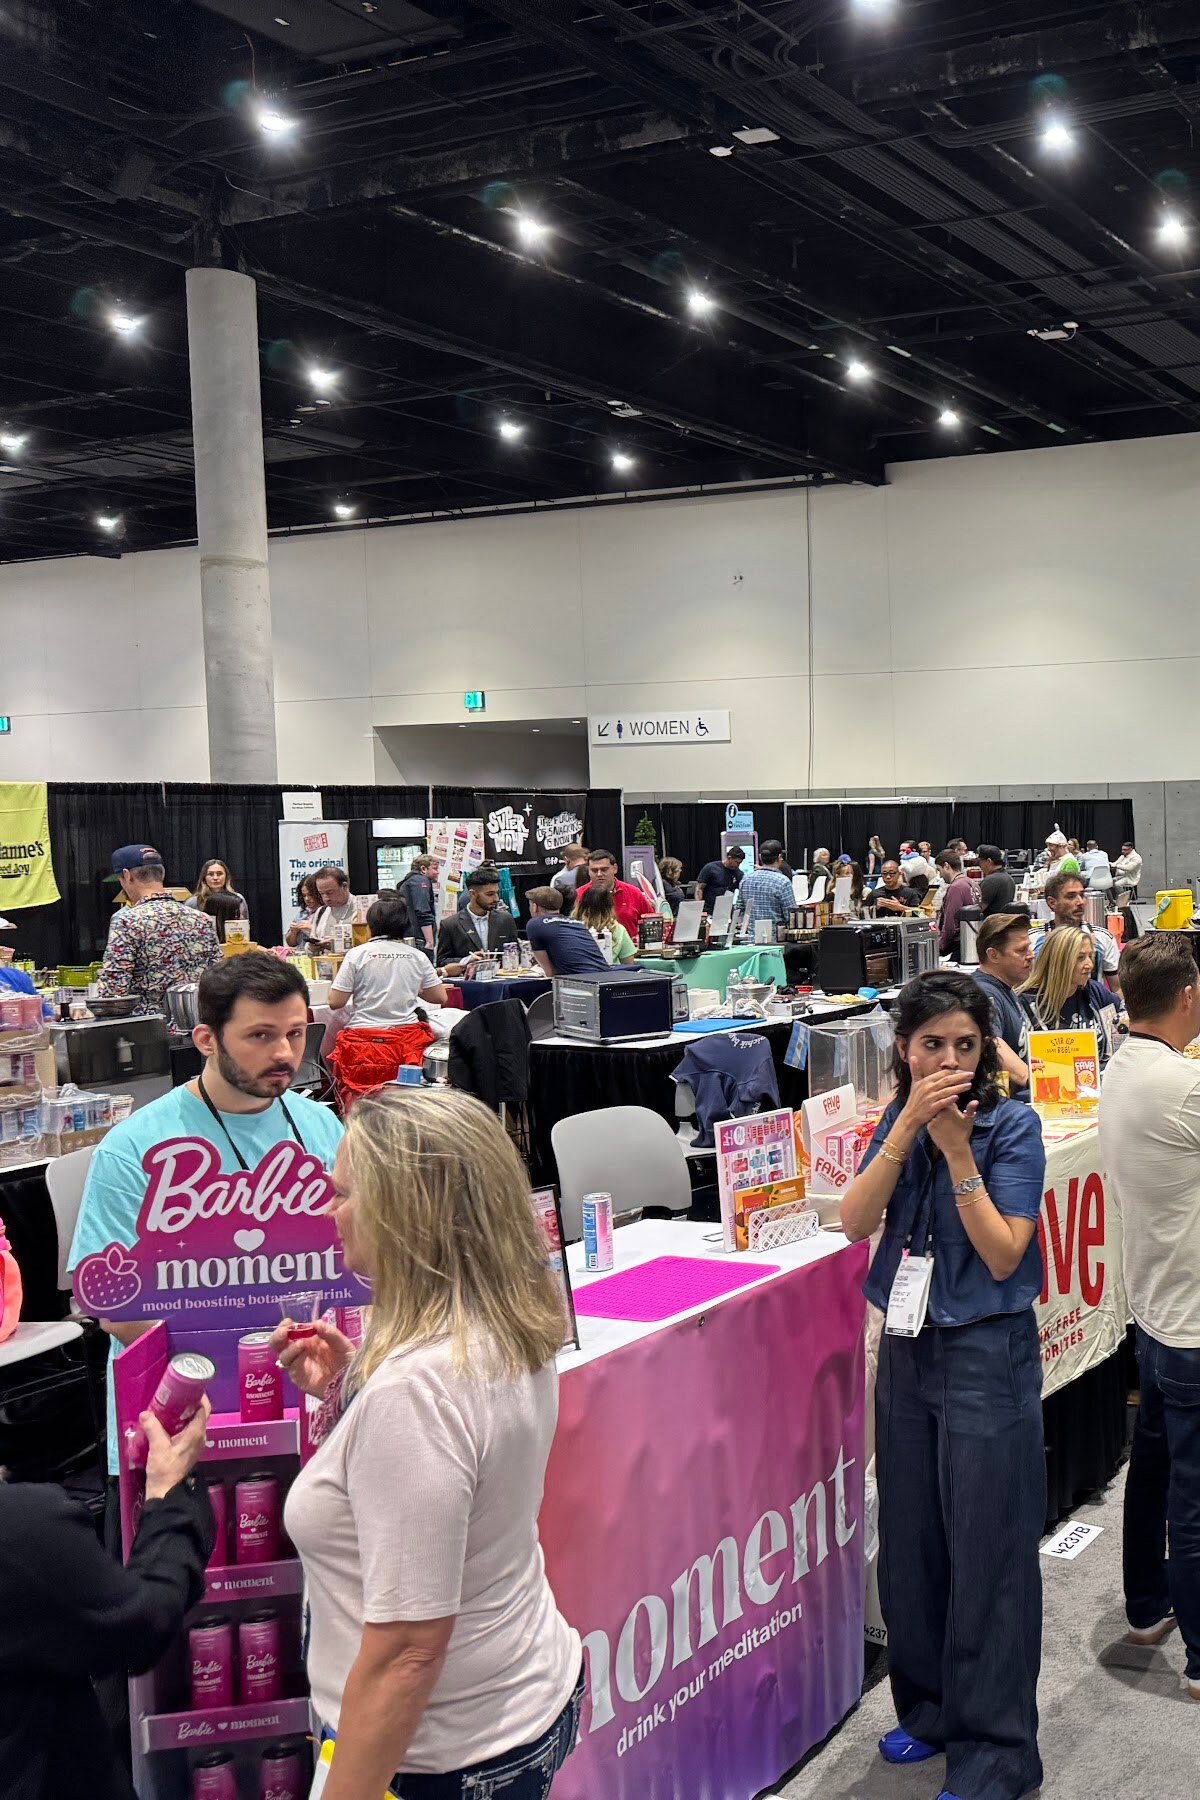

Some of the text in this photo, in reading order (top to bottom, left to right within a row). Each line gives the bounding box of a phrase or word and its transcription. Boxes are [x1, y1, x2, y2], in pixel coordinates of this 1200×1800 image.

[629, 720, 690, 736] WOMEN
[486, 806, 530, 833] SUPER
[289, 858, 344, 869] The original
[290, 871, 312, 882] frid
[1066, 1037, 1075, 1045] UP
[146, 1141, 328, 1234] Barbie
[156, 1244, 343, 1291] moment
[142, 1298, 181, 1312] mood
[185, 1294, 246, 1312] boosting
[245, 1373, 276, 1388] Barbie
[217, 1434, 269, 1449] moment
[239, 1513, 270, 1528] Barbie
[1051, 1525, 1091, 1555] 4237B
[224, 1575, 275, 1591] moment
[246, 1653, 277, 1670] Barbie
[616, 1602, 803, 1757] drink your meditation
[177, 1714, 281, 1740] Barbie moment
